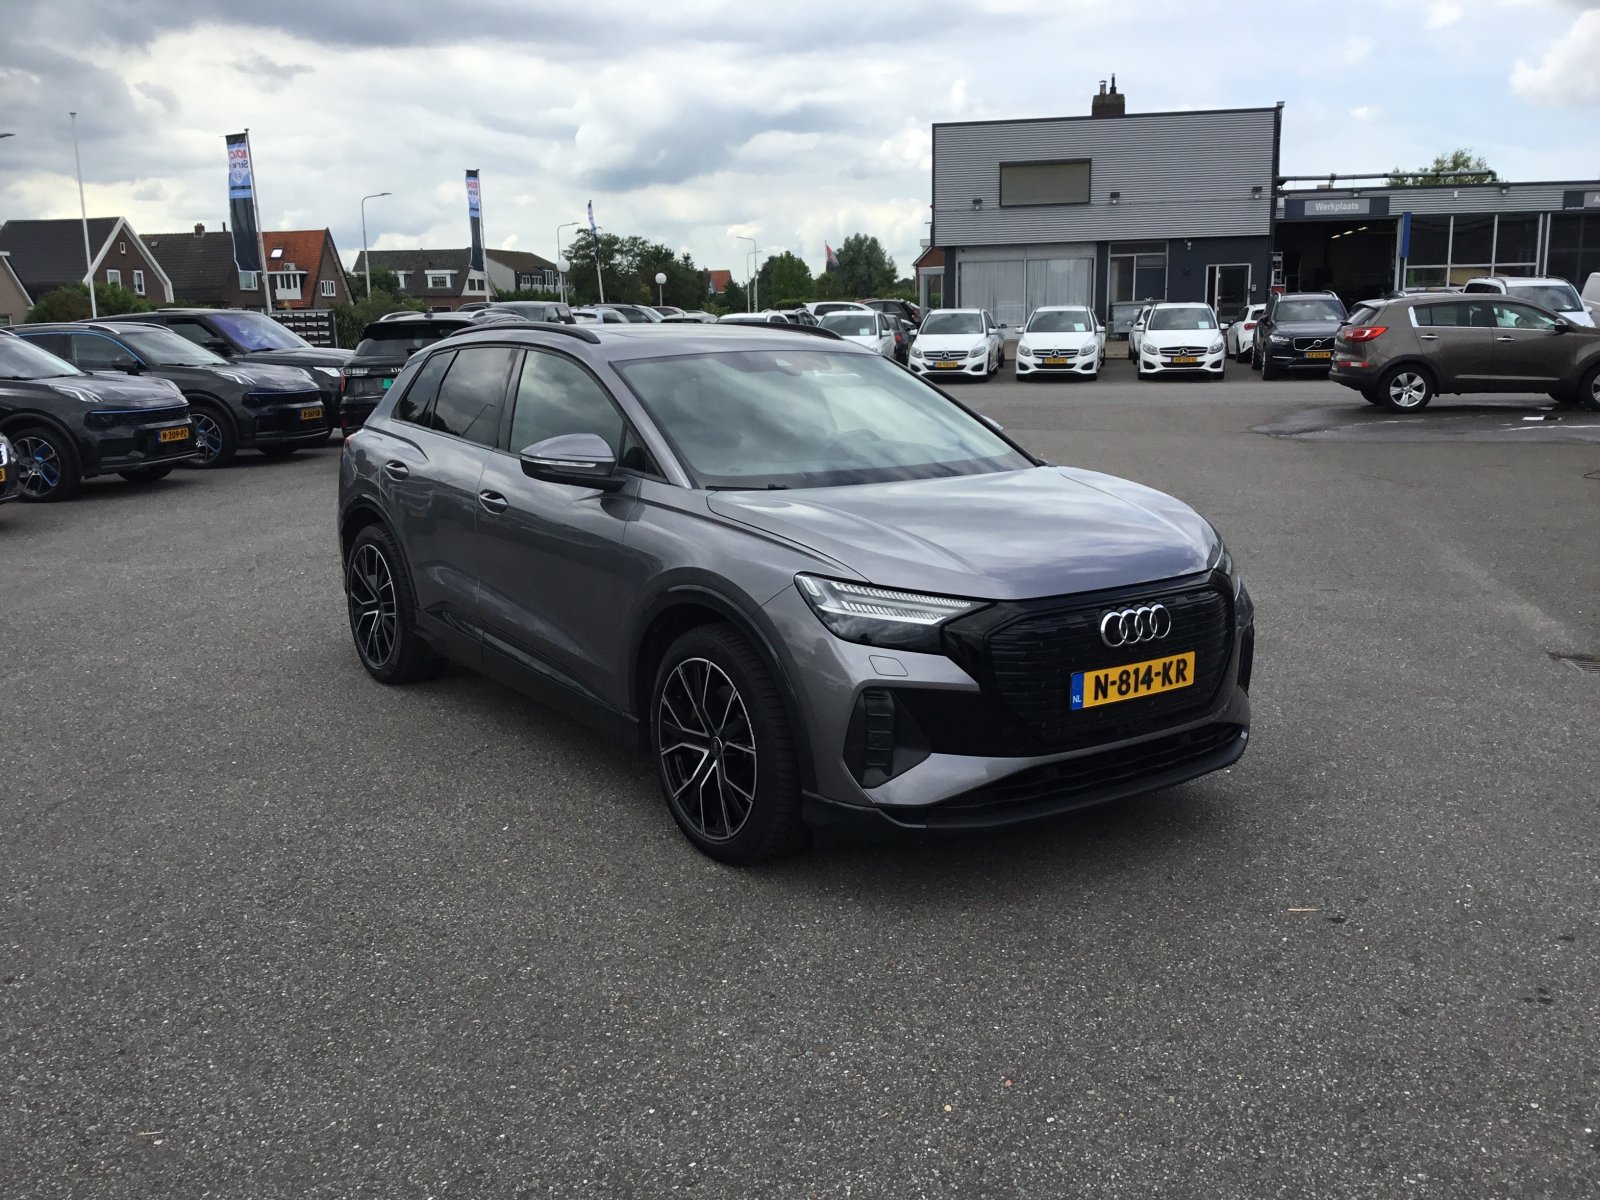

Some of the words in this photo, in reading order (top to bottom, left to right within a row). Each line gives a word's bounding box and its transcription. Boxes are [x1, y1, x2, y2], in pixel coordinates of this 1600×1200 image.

[1315, 202, 1360, 212] Werkplaats
[1072, 695, 1082, 704] NL
[1094, 658, 1188, 701] N-814-KR
